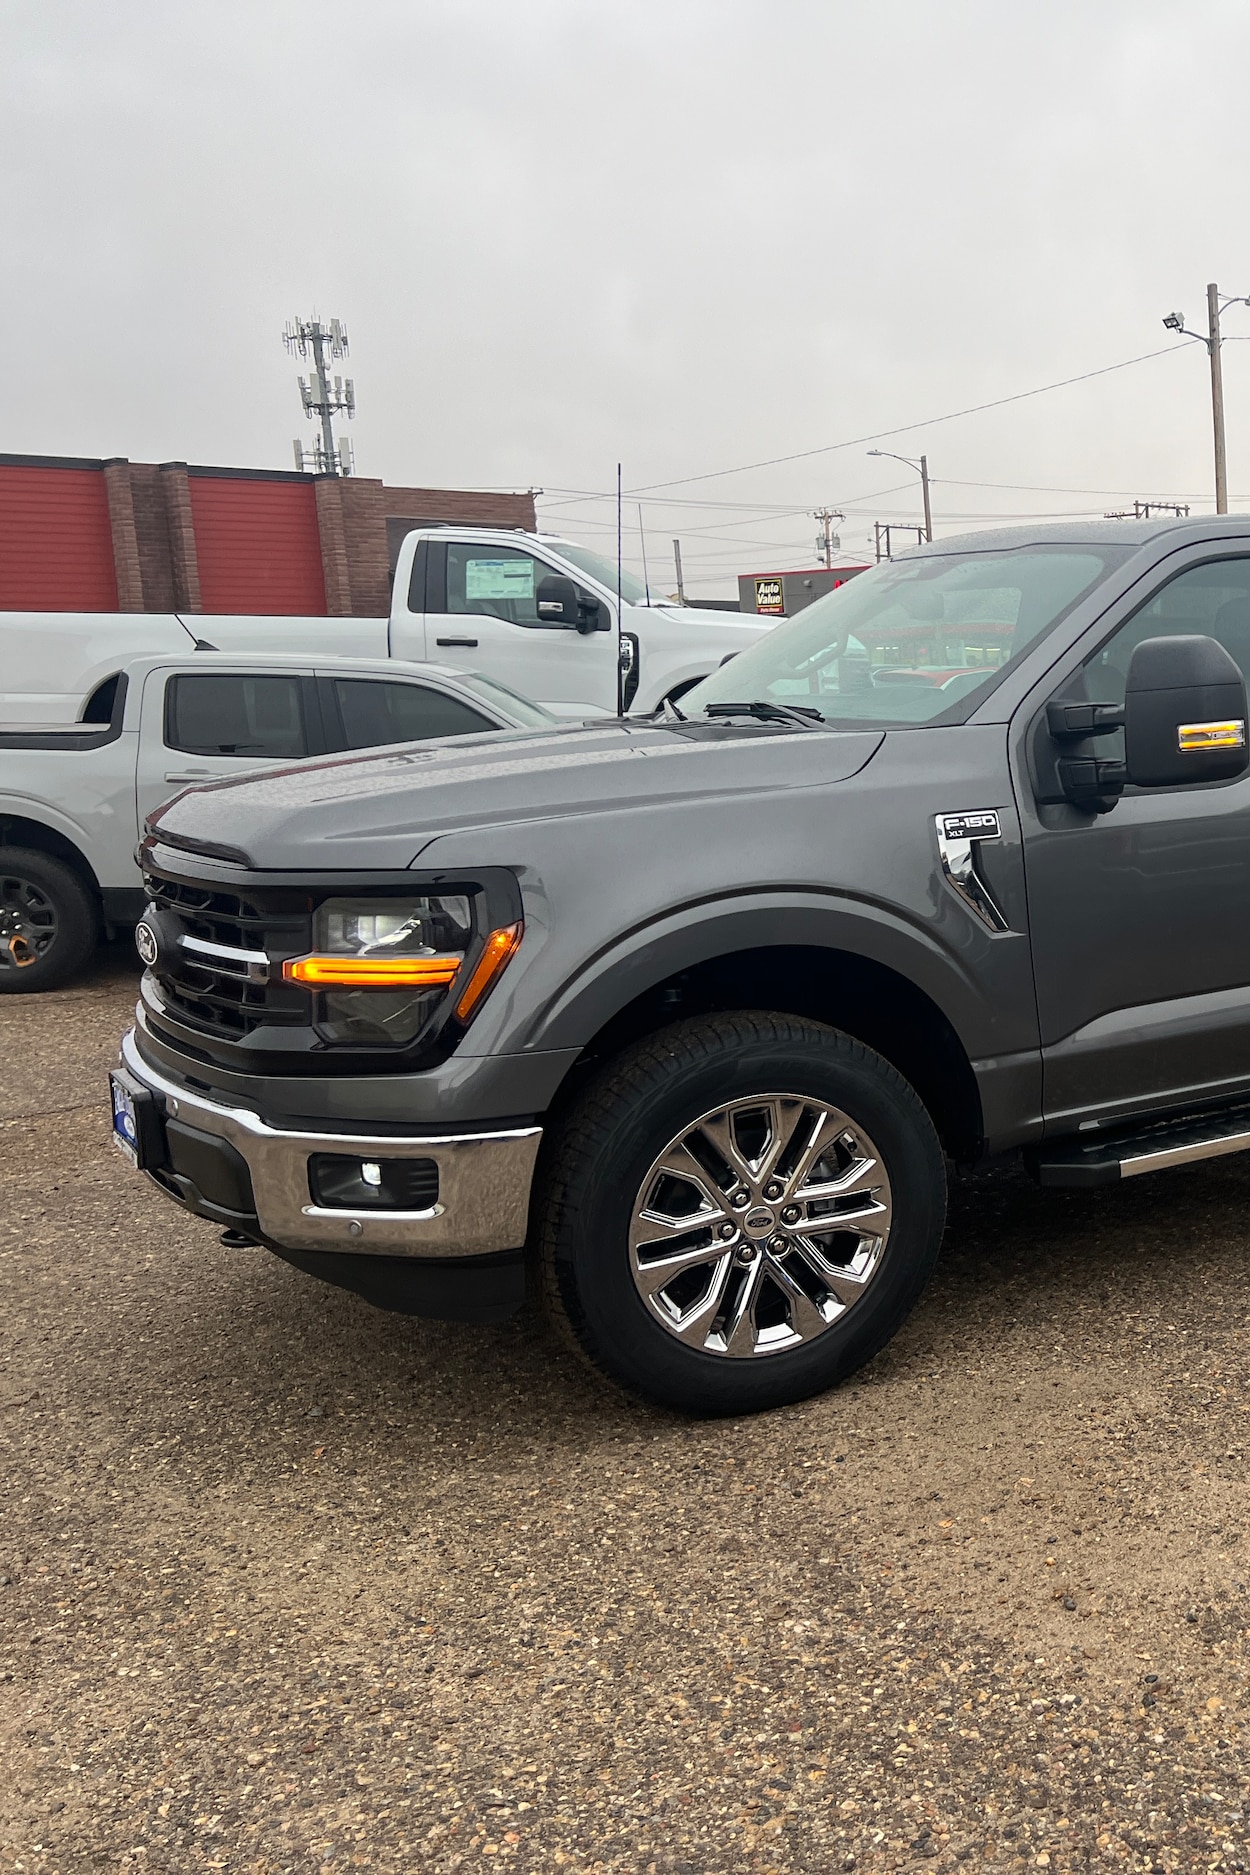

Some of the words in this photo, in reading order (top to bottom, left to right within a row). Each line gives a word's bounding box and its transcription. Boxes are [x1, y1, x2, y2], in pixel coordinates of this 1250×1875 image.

[758, 582, 779, 594] Auto
[757, 594, 781, 605] Value
[944, 814, 997, 831] F-150
[948, 829, 965, 837] XLT
[138, 926, 153, 960] Ford
[750, 1218, 770, 1227] Ford
